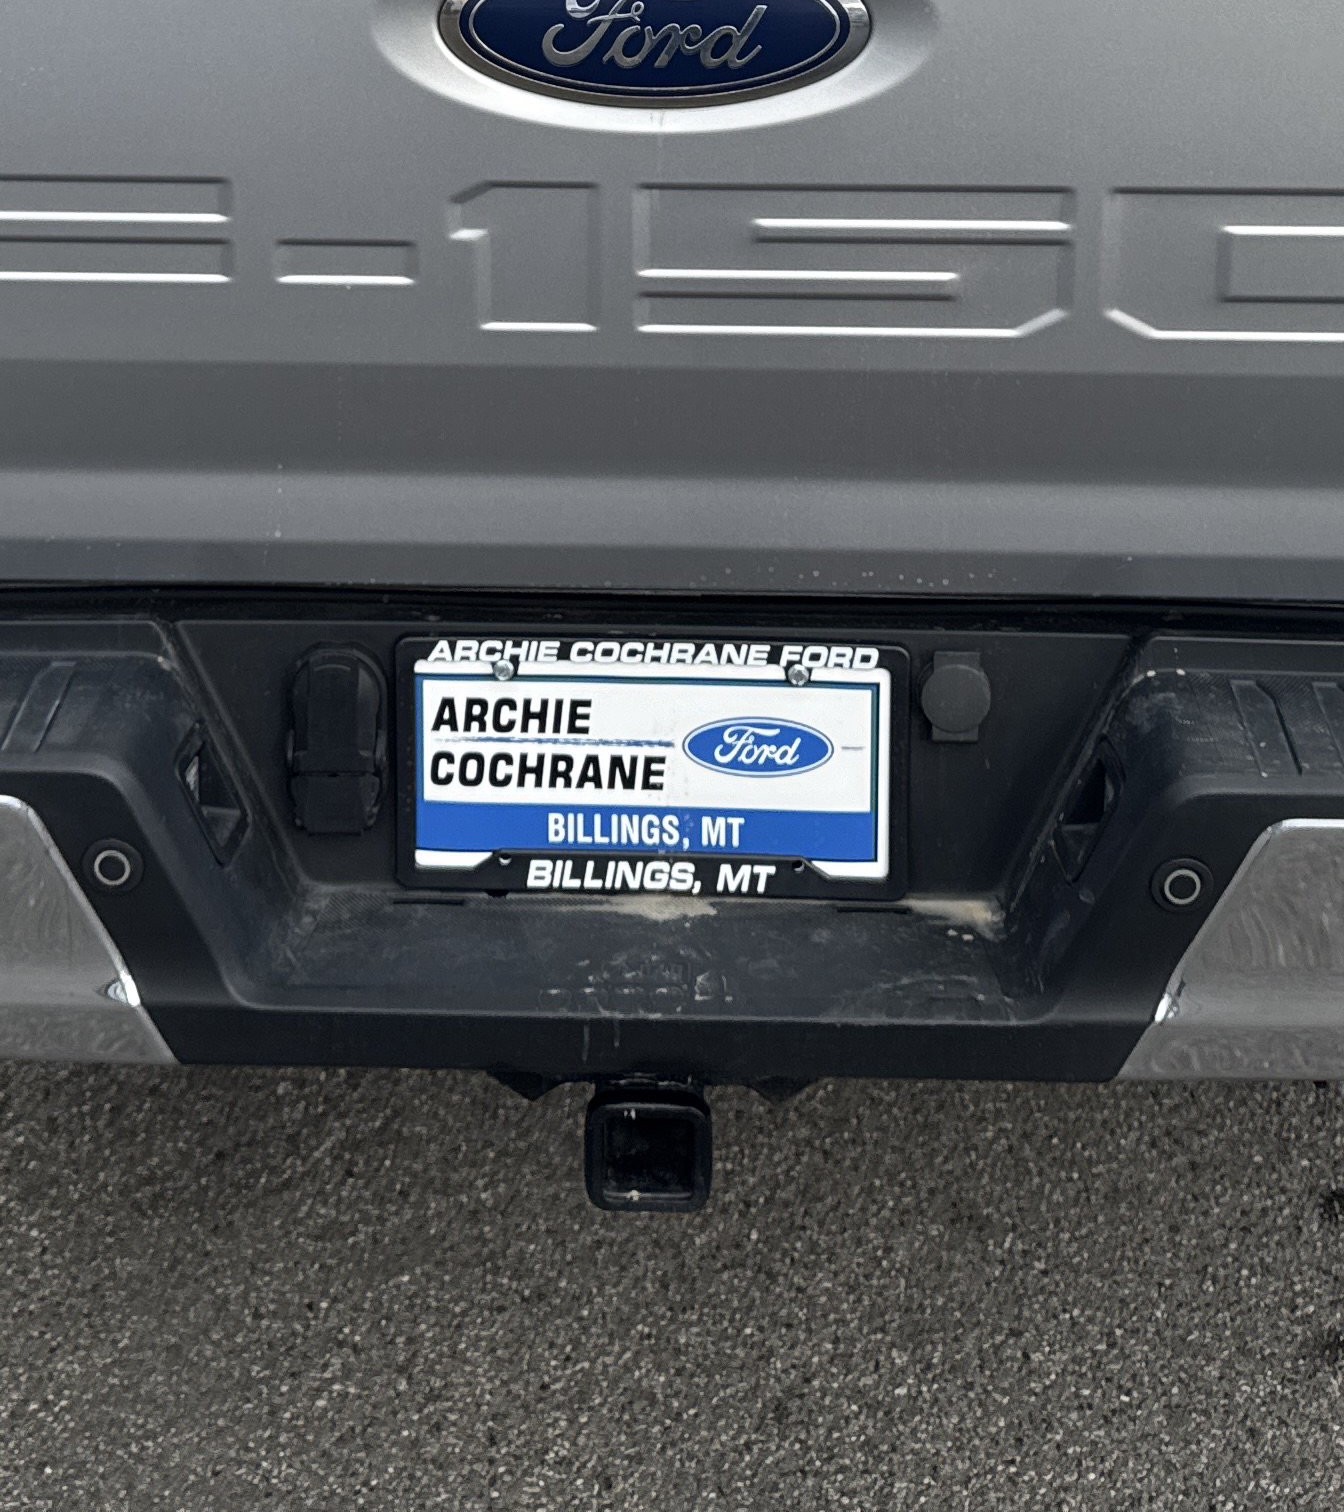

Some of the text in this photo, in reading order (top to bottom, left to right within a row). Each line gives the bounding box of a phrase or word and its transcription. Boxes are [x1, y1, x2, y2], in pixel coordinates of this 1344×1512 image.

[427, 640, 880, 670] ARCHIE COCHRANE FORD
[431, 697, 592, 734] ARCHIE
[713, 725, 800, 766] Ford
[429, 750, 667, 791] COCHRANE
[547, 813, 745, 850] BILLINGS, MT
[525, 859, 776, 895] BILLINGS, MT
